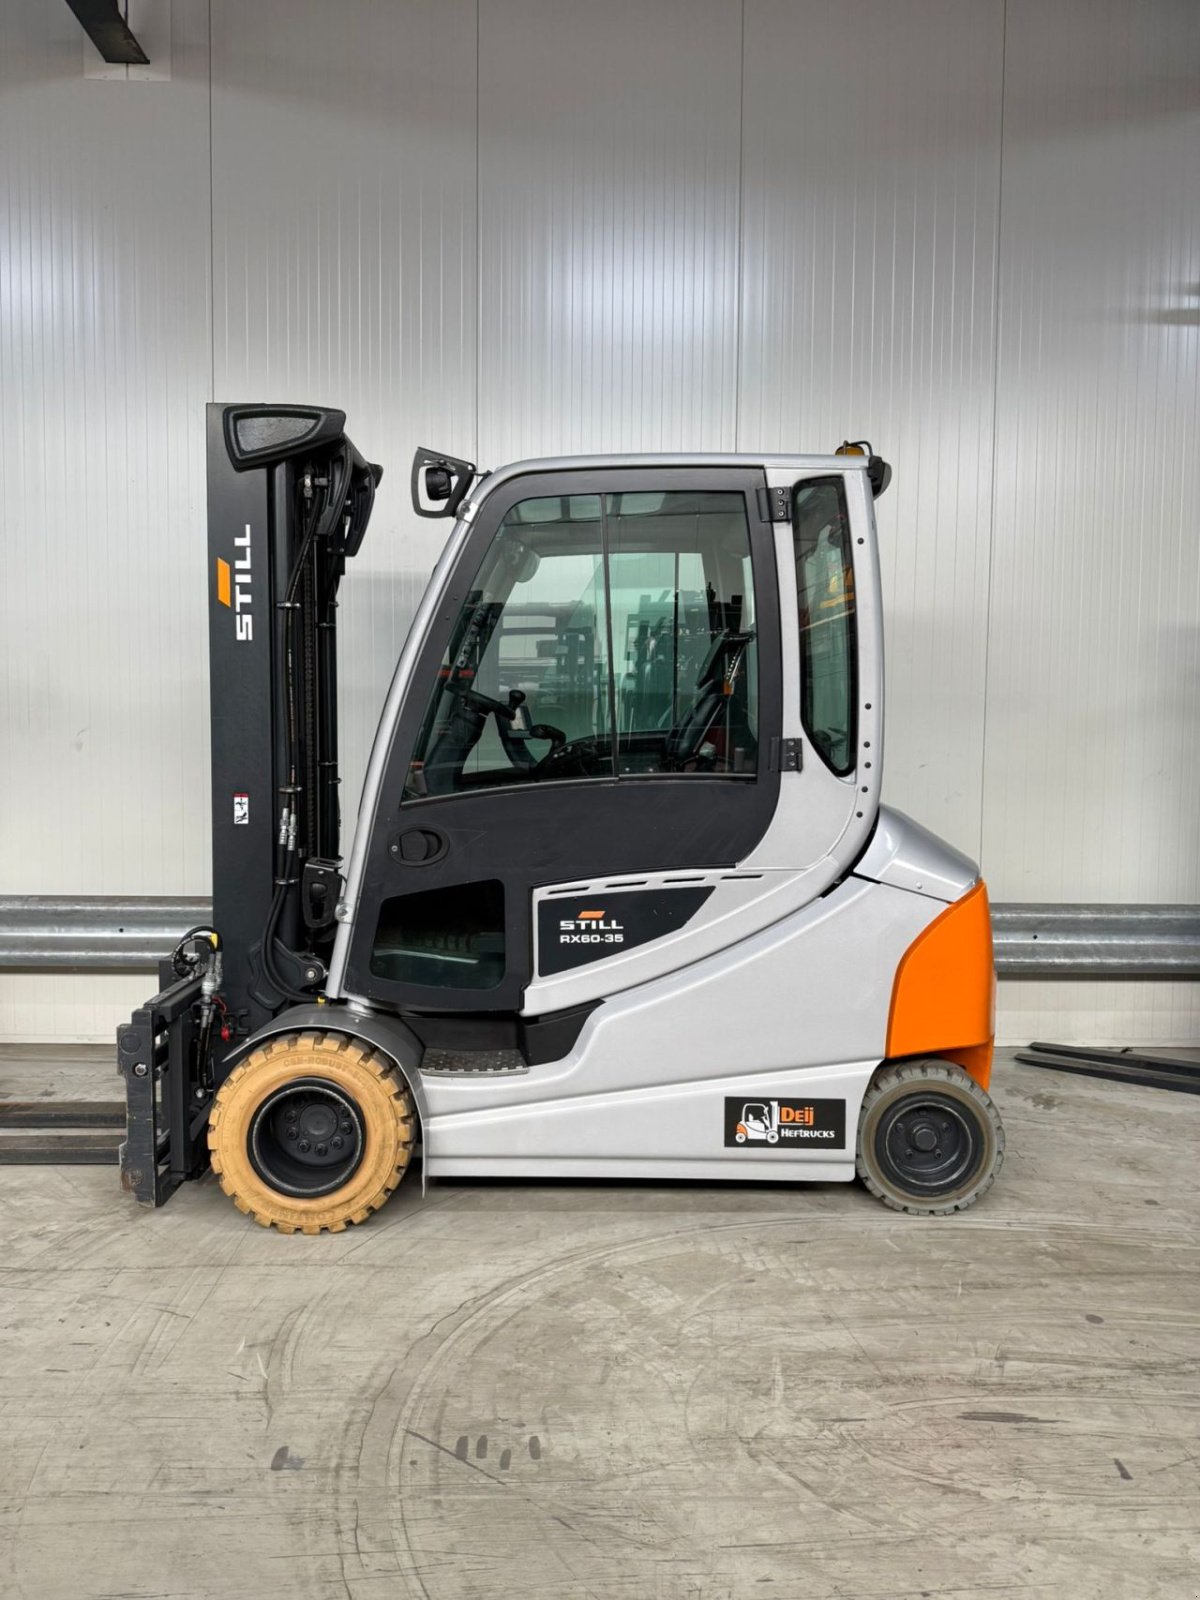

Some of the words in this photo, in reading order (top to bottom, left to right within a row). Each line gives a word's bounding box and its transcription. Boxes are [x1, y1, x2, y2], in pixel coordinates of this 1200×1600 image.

[234, 524, 252, 641] STILL
[560, 920, 624, 930] STILL
[560, 934, 624, 943] RX60-35
